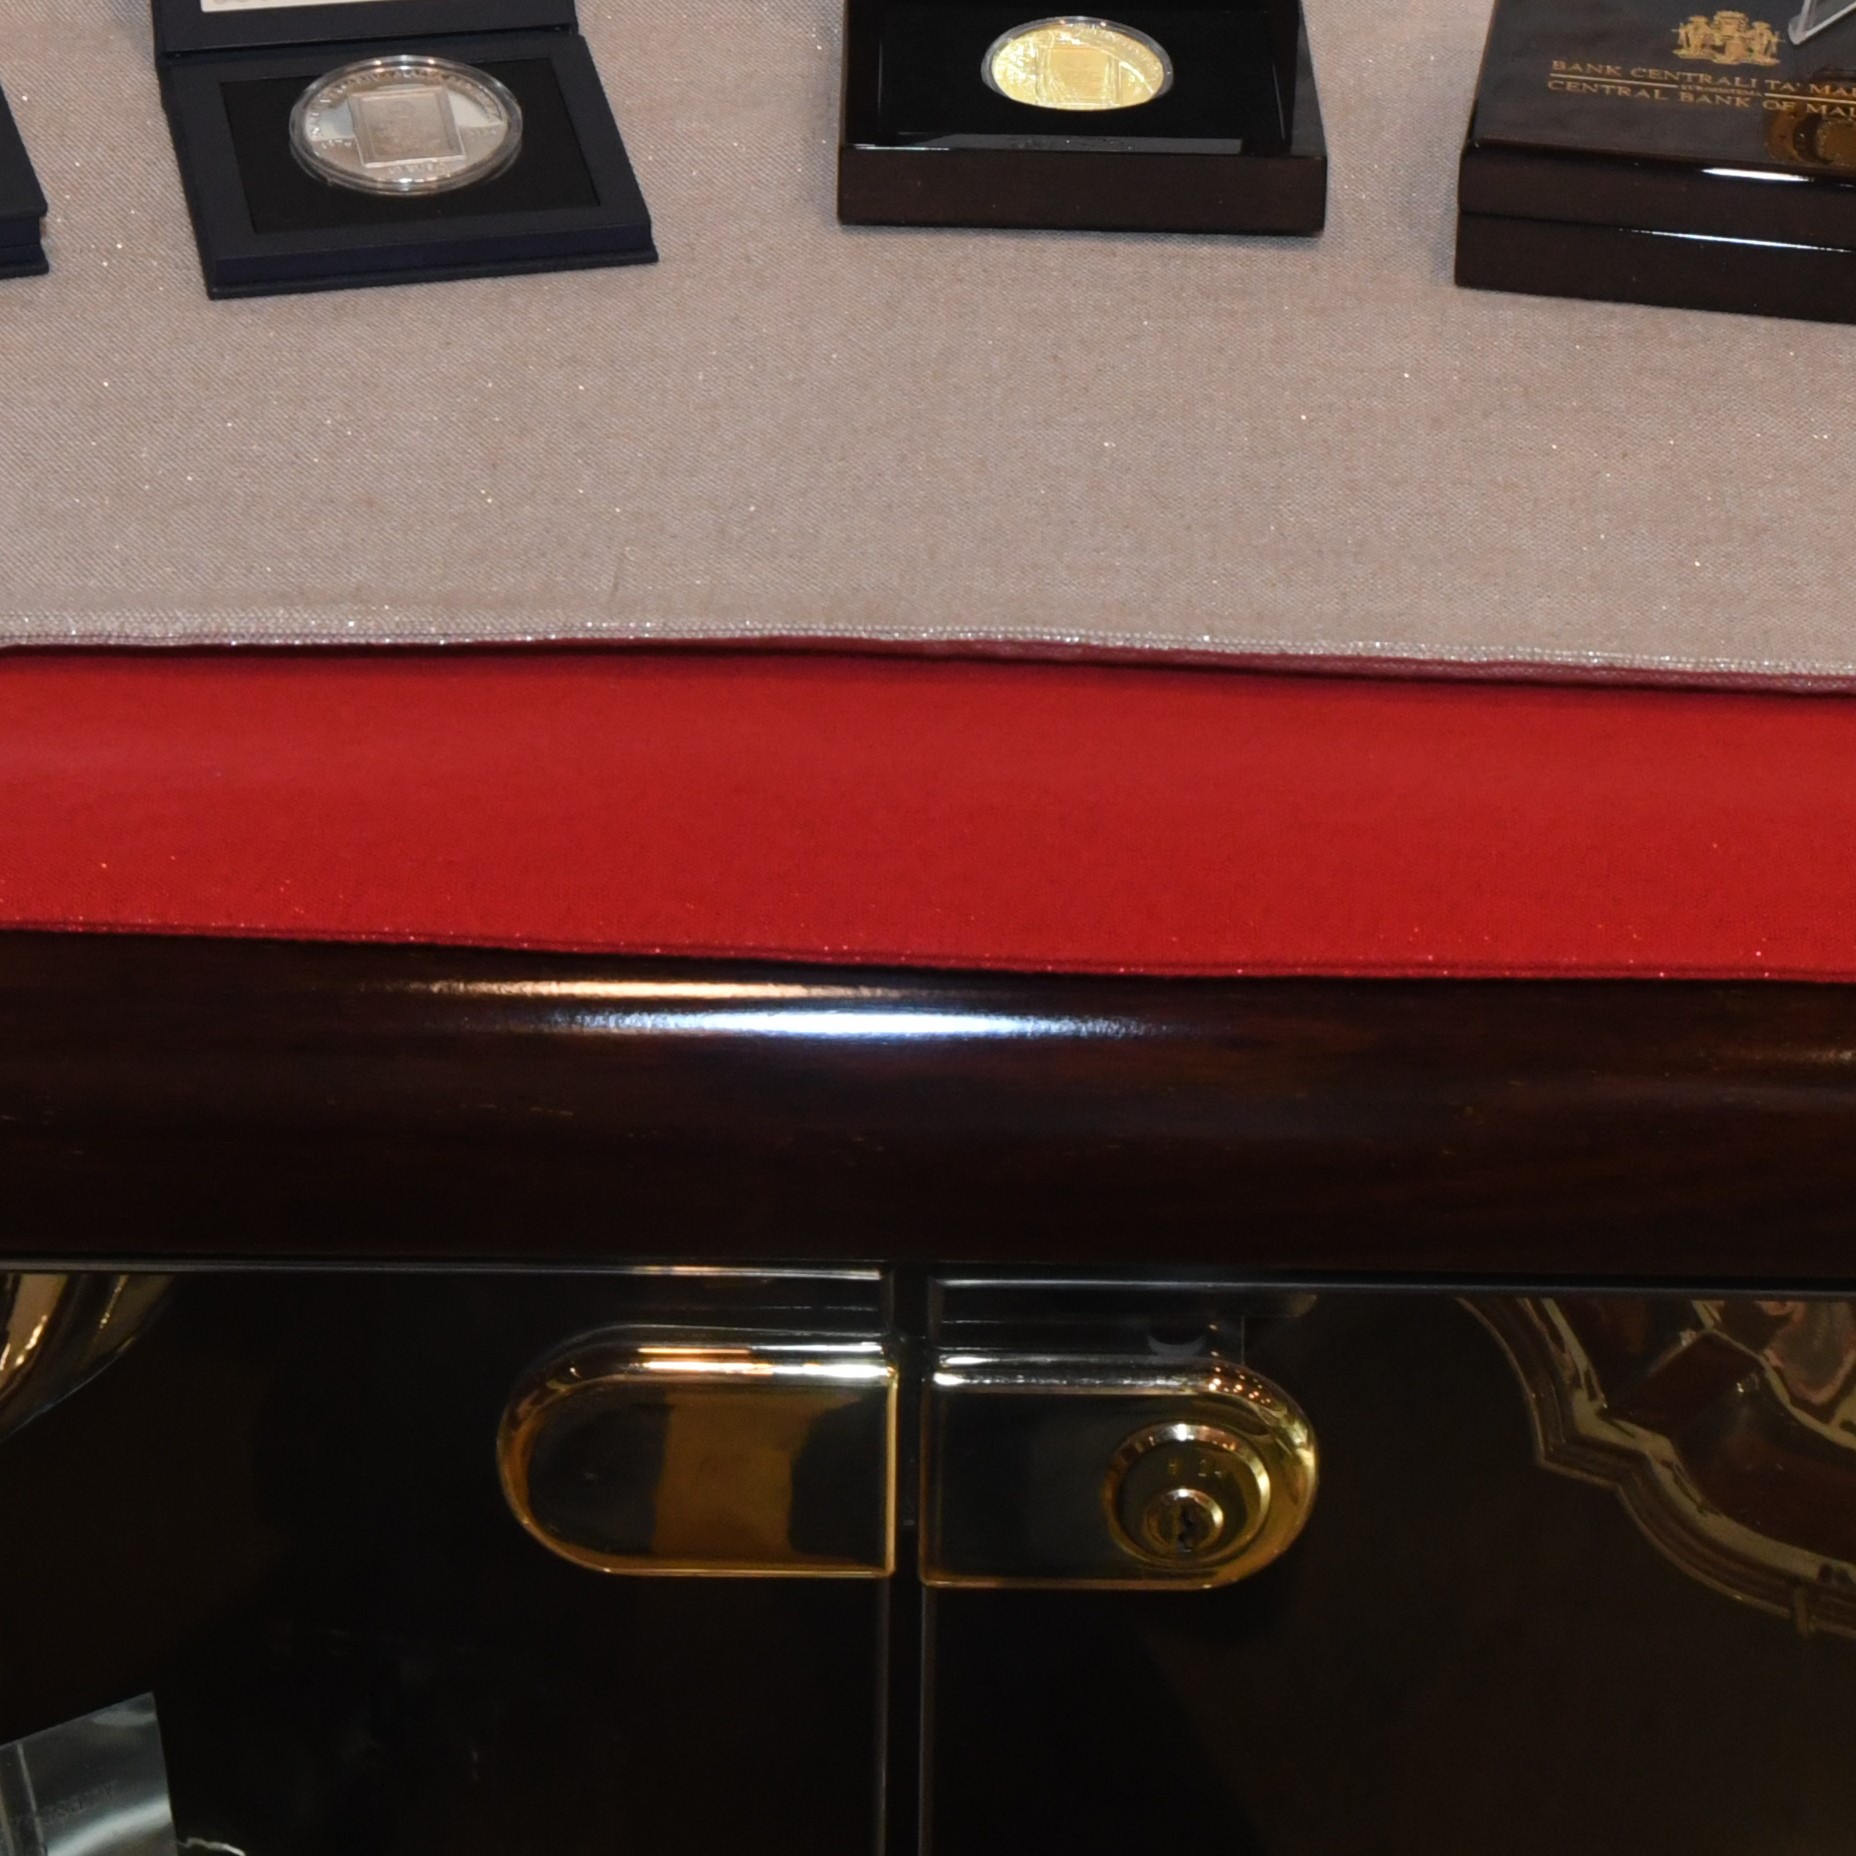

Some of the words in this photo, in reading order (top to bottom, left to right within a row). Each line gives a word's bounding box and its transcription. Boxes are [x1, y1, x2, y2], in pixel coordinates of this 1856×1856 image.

[1552, 60, 1622, 76] BANK
[1547, 81, 1670, 101] CENTRAL
[1680, 92, 1751, 108] BANK
